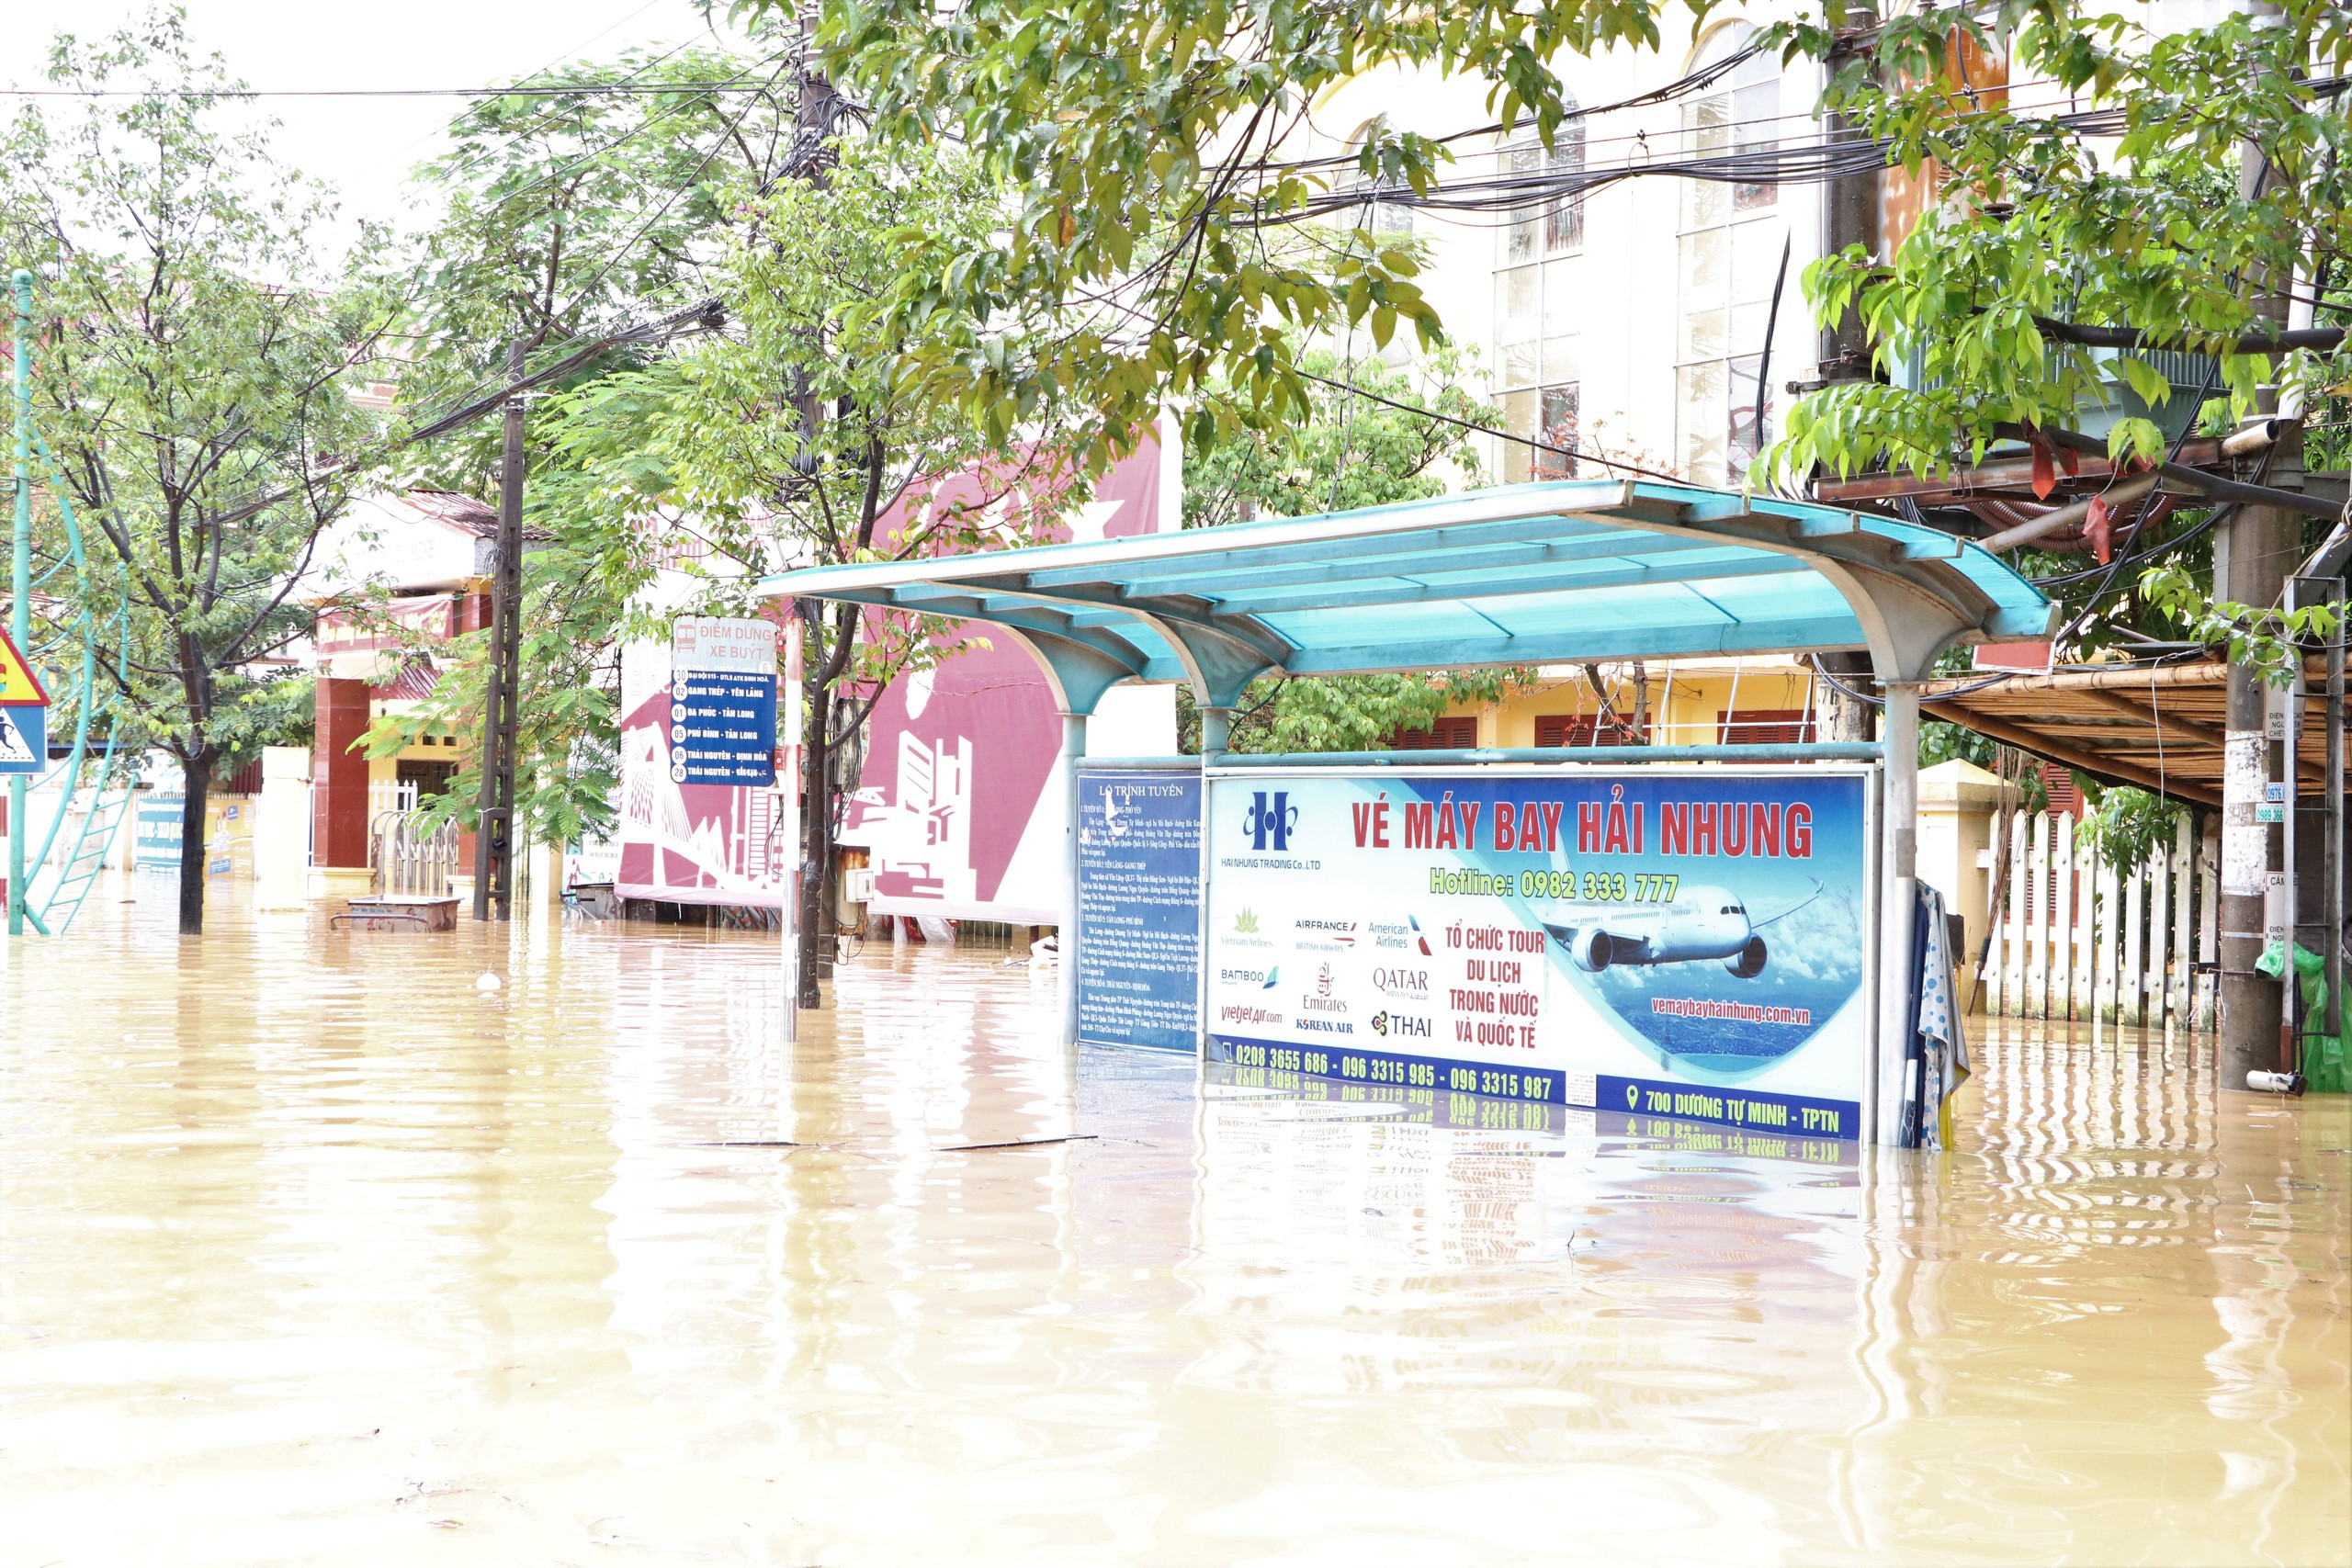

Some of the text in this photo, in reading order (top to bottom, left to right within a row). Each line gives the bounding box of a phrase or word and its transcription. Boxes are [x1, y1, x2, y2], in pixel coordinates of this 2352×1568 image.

[710, 644, 763, 660] XE BUÝT
[676, 670, 686, 682] 30
[676, 687, 684, 696] 02
[688, 688, 707, 696] GANG
[708, 686, 725, 697] THÉP
[730, 688, 744, 697] YÊN
[674, 708, 684, 717] 01
[699, 706, 717, 718] PHÚC
[737, 710, 754, 719] LONG
[674, 729, 684, 739] 05
[740, 731, 757, 740] LONG
[674, 751, 684, 761] 06
[687, 749, 703, 760] THÁI
[703, 750, 731, 761] NGUYÊN
[674, 768, 684, 778] 28
[687, 765, 703, 776] THÁI
[703, 766, 731, 777] NGUYÊN
[1114, 784, 1146, 796] TRÌNH
[1148, 784, 1183, 796] TUYẾN
[1351, 784, 1812, 858] VÉ MÁY BAY HẢI NHUNG
[1234, 859, 1259, 868] NHUNG
[1260, 859, 1292, 869] TRADING
[1430, 868, 1679, 903] Hotline: 0982 333 777
[1295, 919, 1349, 931] AIRFRANCE
[1368, 921, 1408, 935] American
[1221, 935, 1273, 948] Vietnam Airlines
[1375, 935, 1408, 949] Airlines
[1445, 919, 1544, 953] TỔ CHỨC TOUR
[1295, 942, 1344, 953] BRITISH AIRWAYS
[1221, 969, 1264, 982] BAMBOO
[1373, 967, 1429, 991] QATAR
[1466, 959, 1521, 987] DU LỊCH
[1303, 994, 1348, 1013] Emirates
[1449, 988, 1539, 1017] TRONG NƯỚC
[1651, 997, 1810, 1025] vemaybayhainhung.com.vn
[1295, 1018, 1353, 1034] KOREAN AIR
[1391, 1014, 1431, 1037] THAI
[1455, 1017, 1537, 1049] VÀ QUỐC TẾ
[1236, 1044, 1266, 1067] 0208
[1270, 1047, 1301, 1071] 3655
[1305, 1051, 1329, 1075] 686
[1342, 1055, 1367, 1079] 096
[1371, 1059, 1405, 1083] 3315
[1408, 1063, 1435, 1088] 985
[1450, 1067, 1477, 1092] 096
[1482, 1071, 1519, 1097] 3315
[1523, 1076, 1553, 1100] 987
[1645, 1090, 1672, 1113] 700
[1674, 1092, 1724, 1120] DƯƠNG
[1726, 1099, 1746, 1126] TỰ
[1747, 1101, 1788, 1126] MINH
[1801, 1108, 1840, 1133] TPTN
